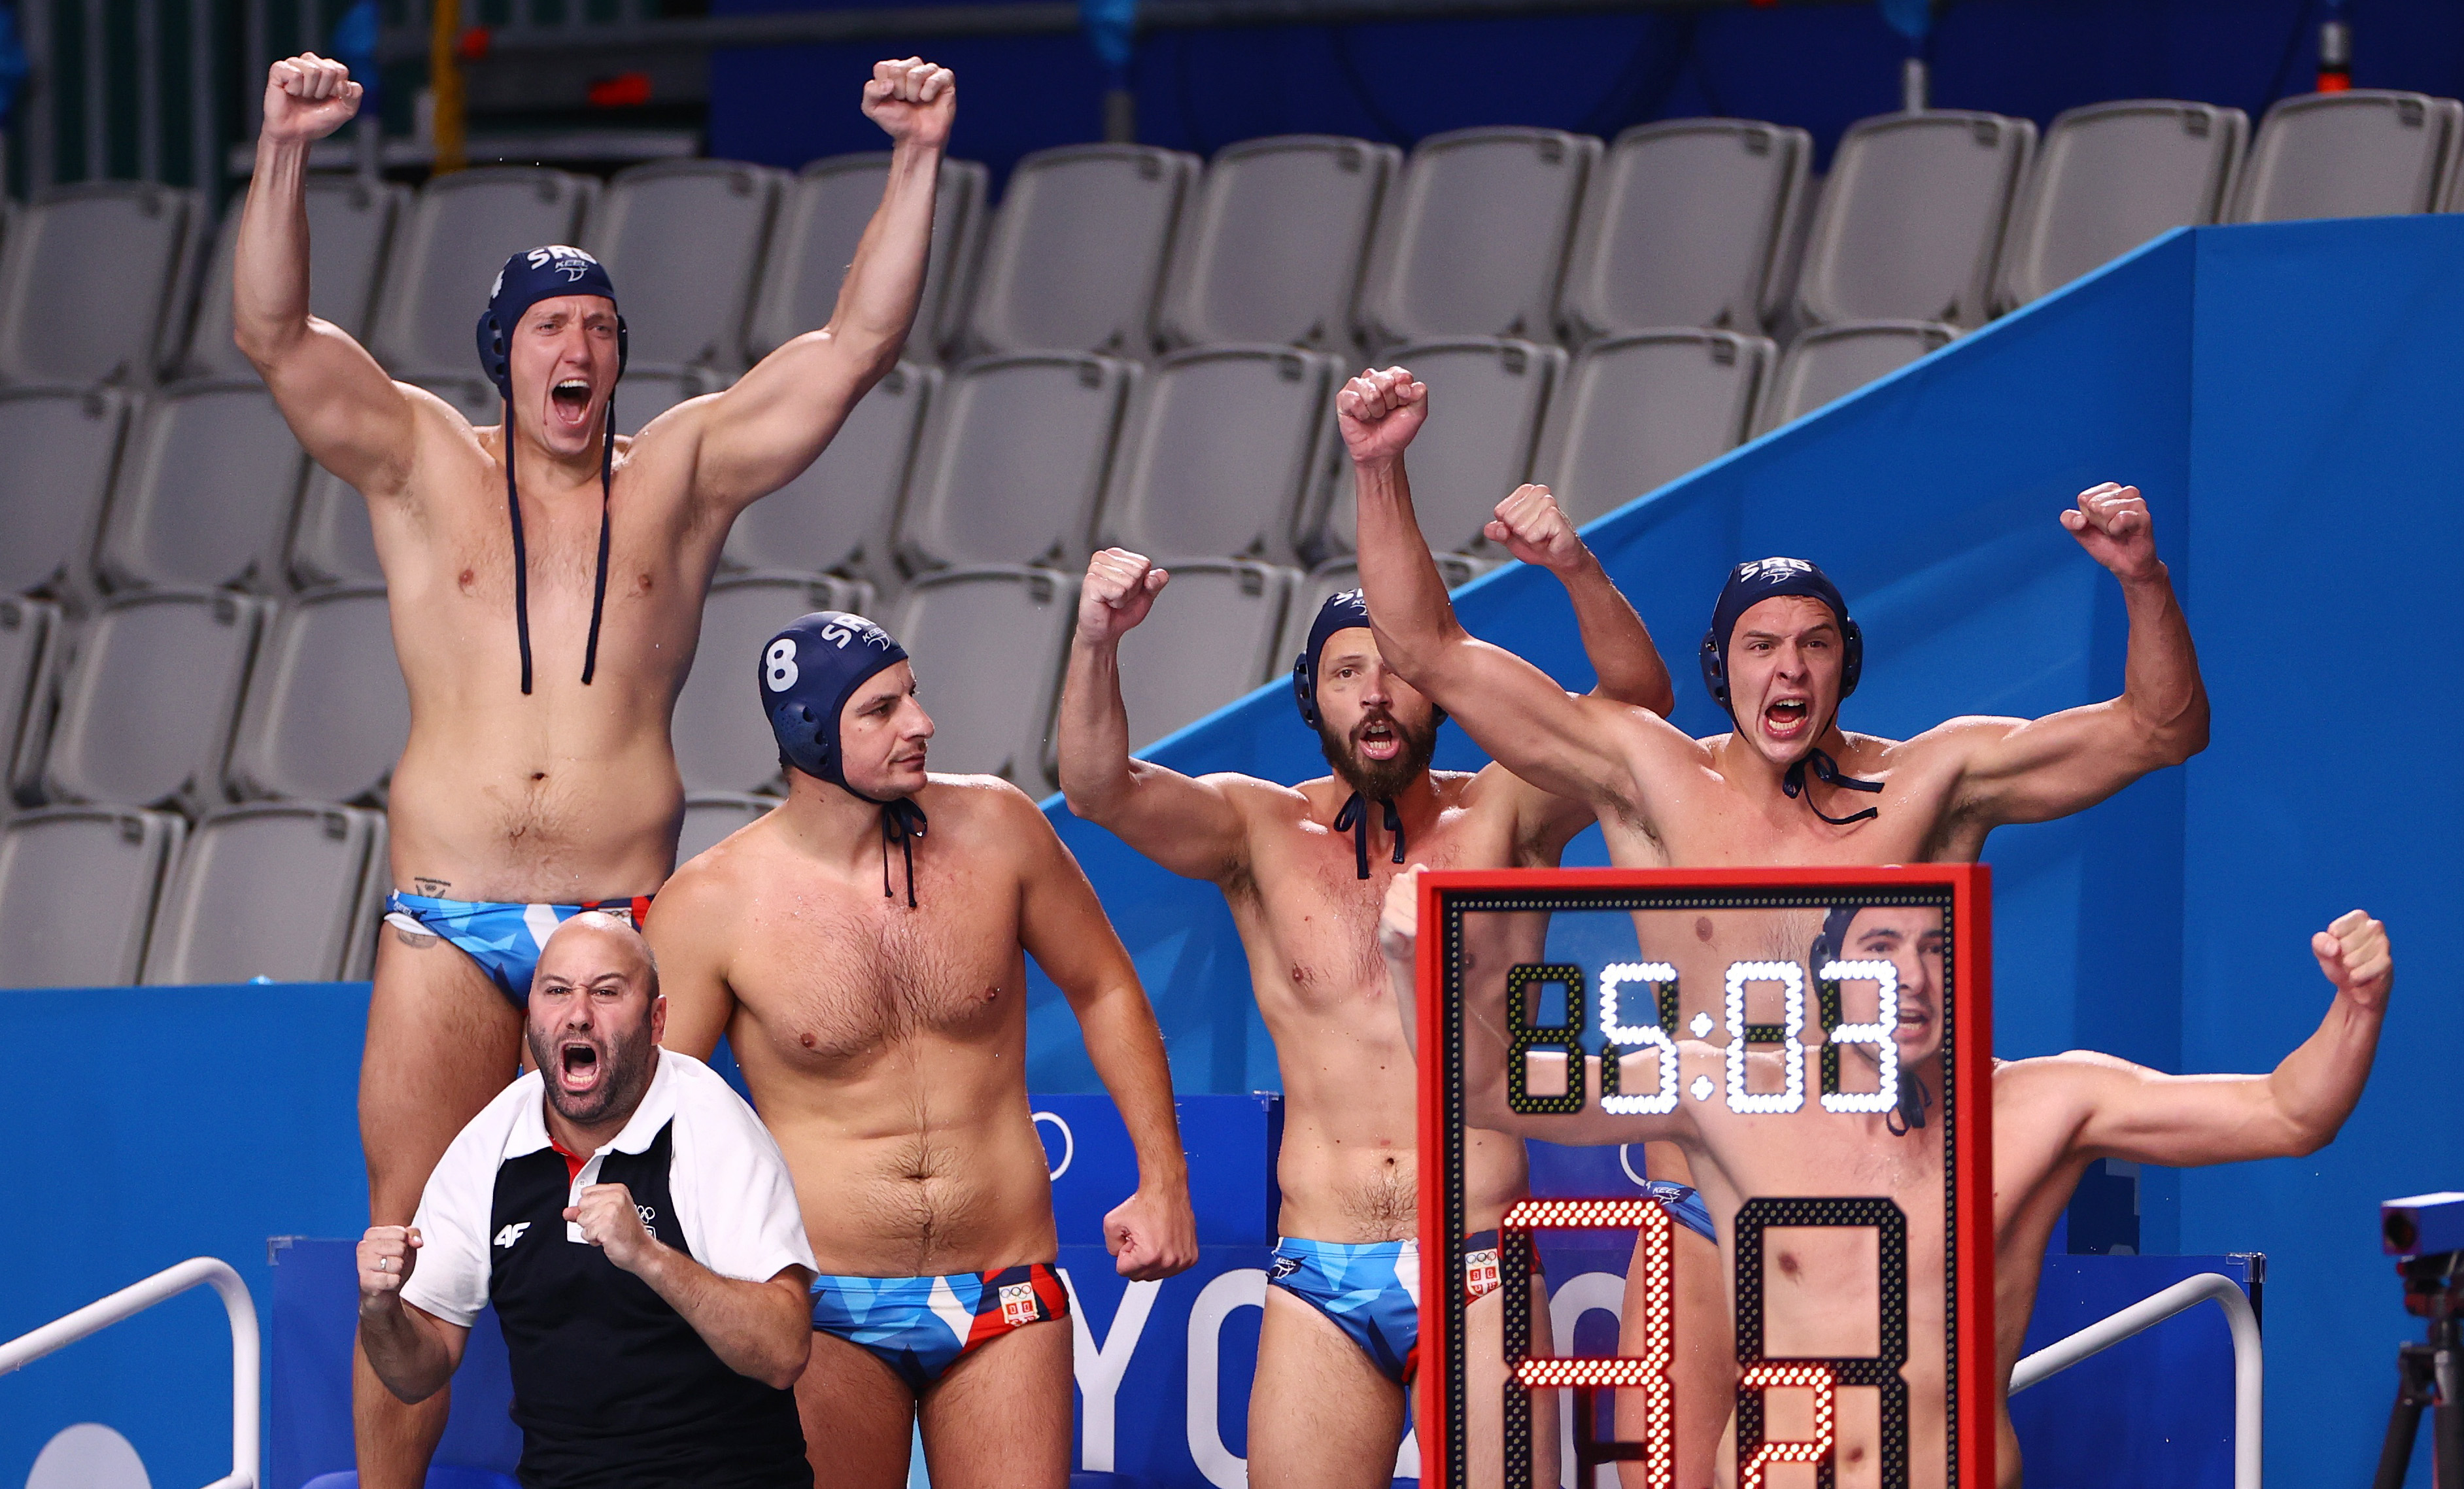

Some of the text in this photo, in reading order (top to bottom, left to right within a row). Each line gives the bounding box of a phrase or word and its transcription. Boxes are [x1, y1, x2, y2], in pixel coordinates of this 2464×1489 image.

[555, 260, 588, 269] KEEL
[1741, 557, 1812, 583] SRB
[821, 614, 876, 649] SR
[766, 638, 798, 693] 8
[1652, 1187, 1681, 1196] KEEL
[493, 1222, 532, 1248] 4F
